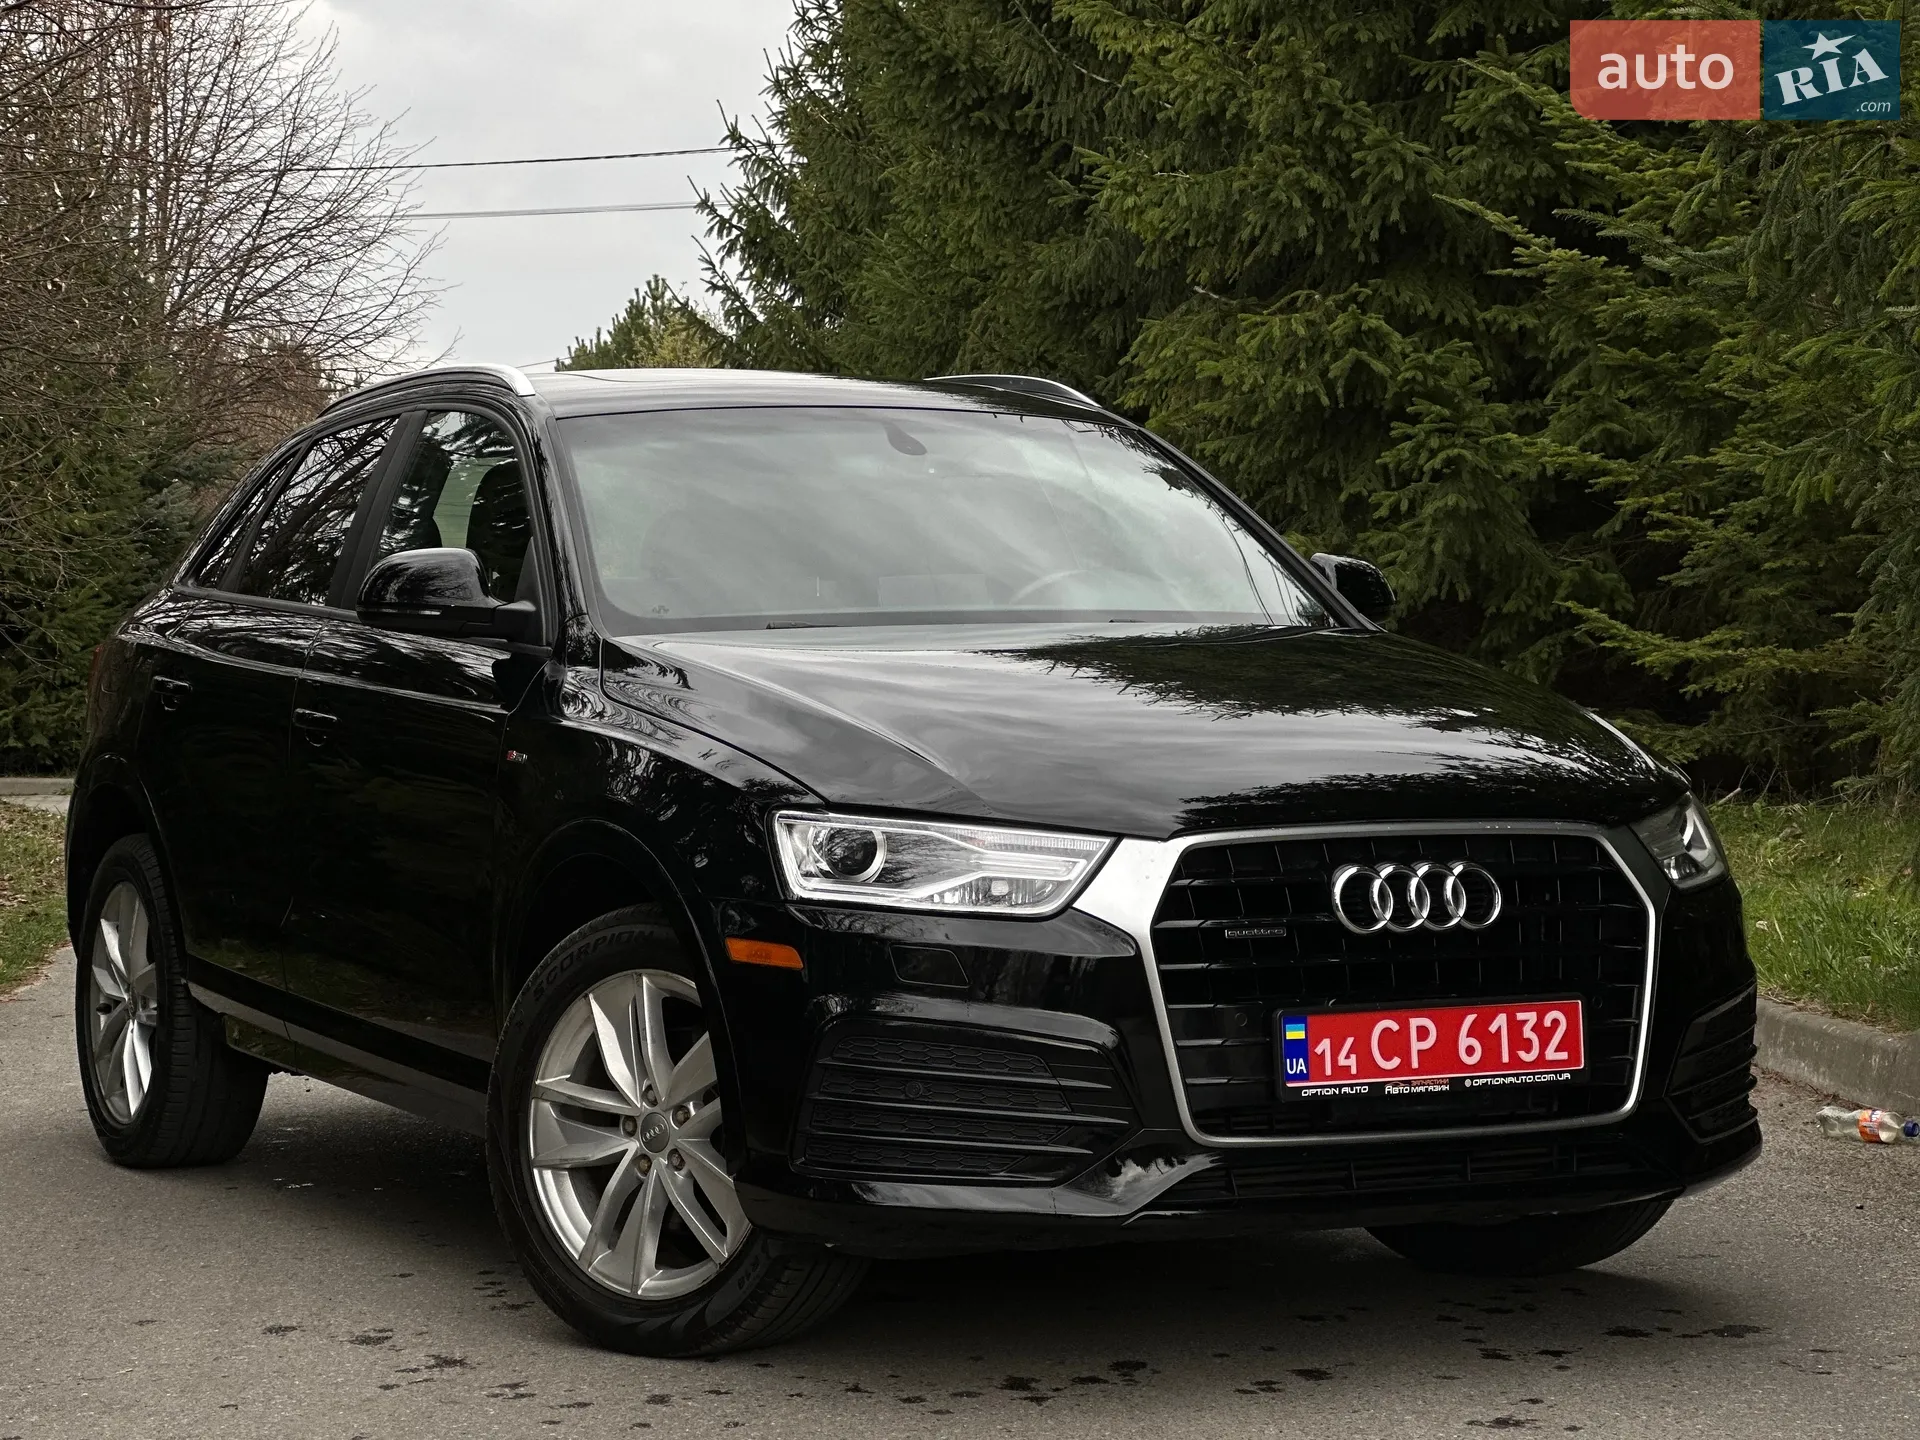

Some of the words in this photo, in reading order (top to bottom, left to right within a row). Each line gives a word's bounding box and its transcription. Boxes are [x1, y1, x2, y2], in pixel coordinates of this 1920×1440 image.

[1228, 928, 1284, 937] quattro
[533, 930, 654, 1001] SCORPION
[1314, 1037, 1357, 1076] 14
[1370, 1017, 1437, 1070] CP
[1458, 1010, 1569, 1066] 6132
[1286, 1058, 1307, 1074] UA
[1341, 1086, 1369, 1095] AUTO
